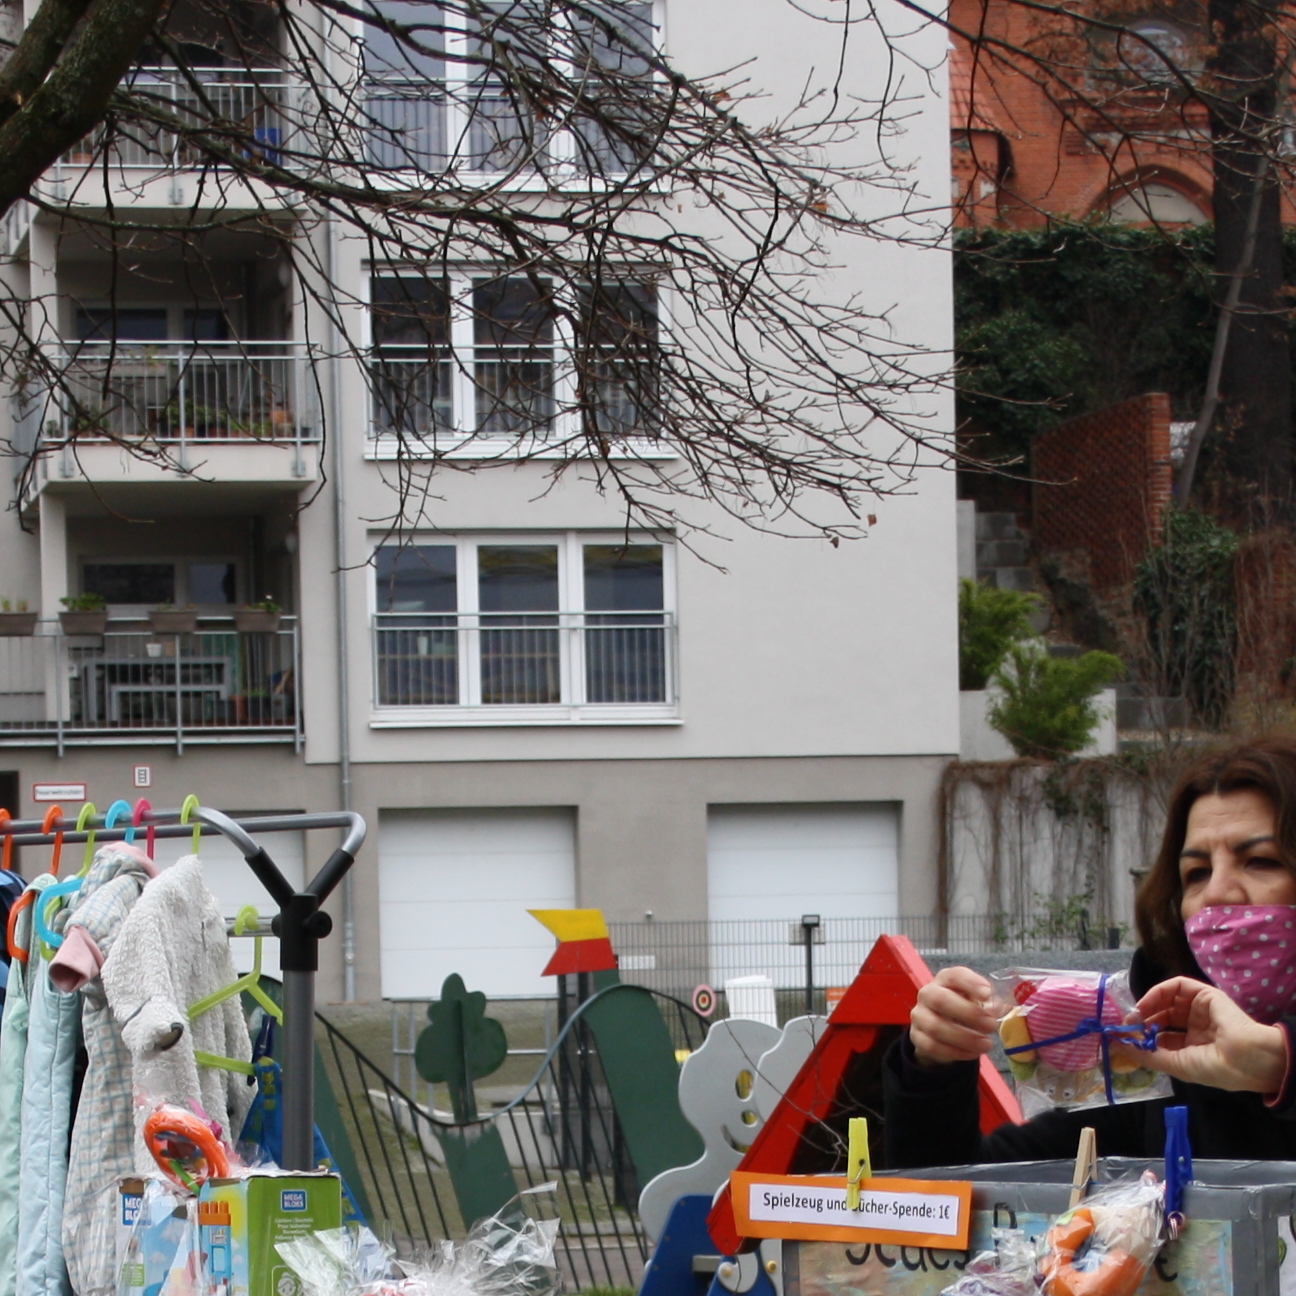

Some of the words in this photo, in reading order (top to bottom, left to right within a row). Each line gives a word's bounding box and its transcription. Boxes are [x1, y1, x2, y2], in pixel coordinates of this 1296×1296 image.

[763, 1192, 823, 1213] Spielzeug
[826, 1196, 848, 1212] und
[851, 1198, 936, 1219] ücher-Spende:
[938, 1204, 951, 1220] 1€
